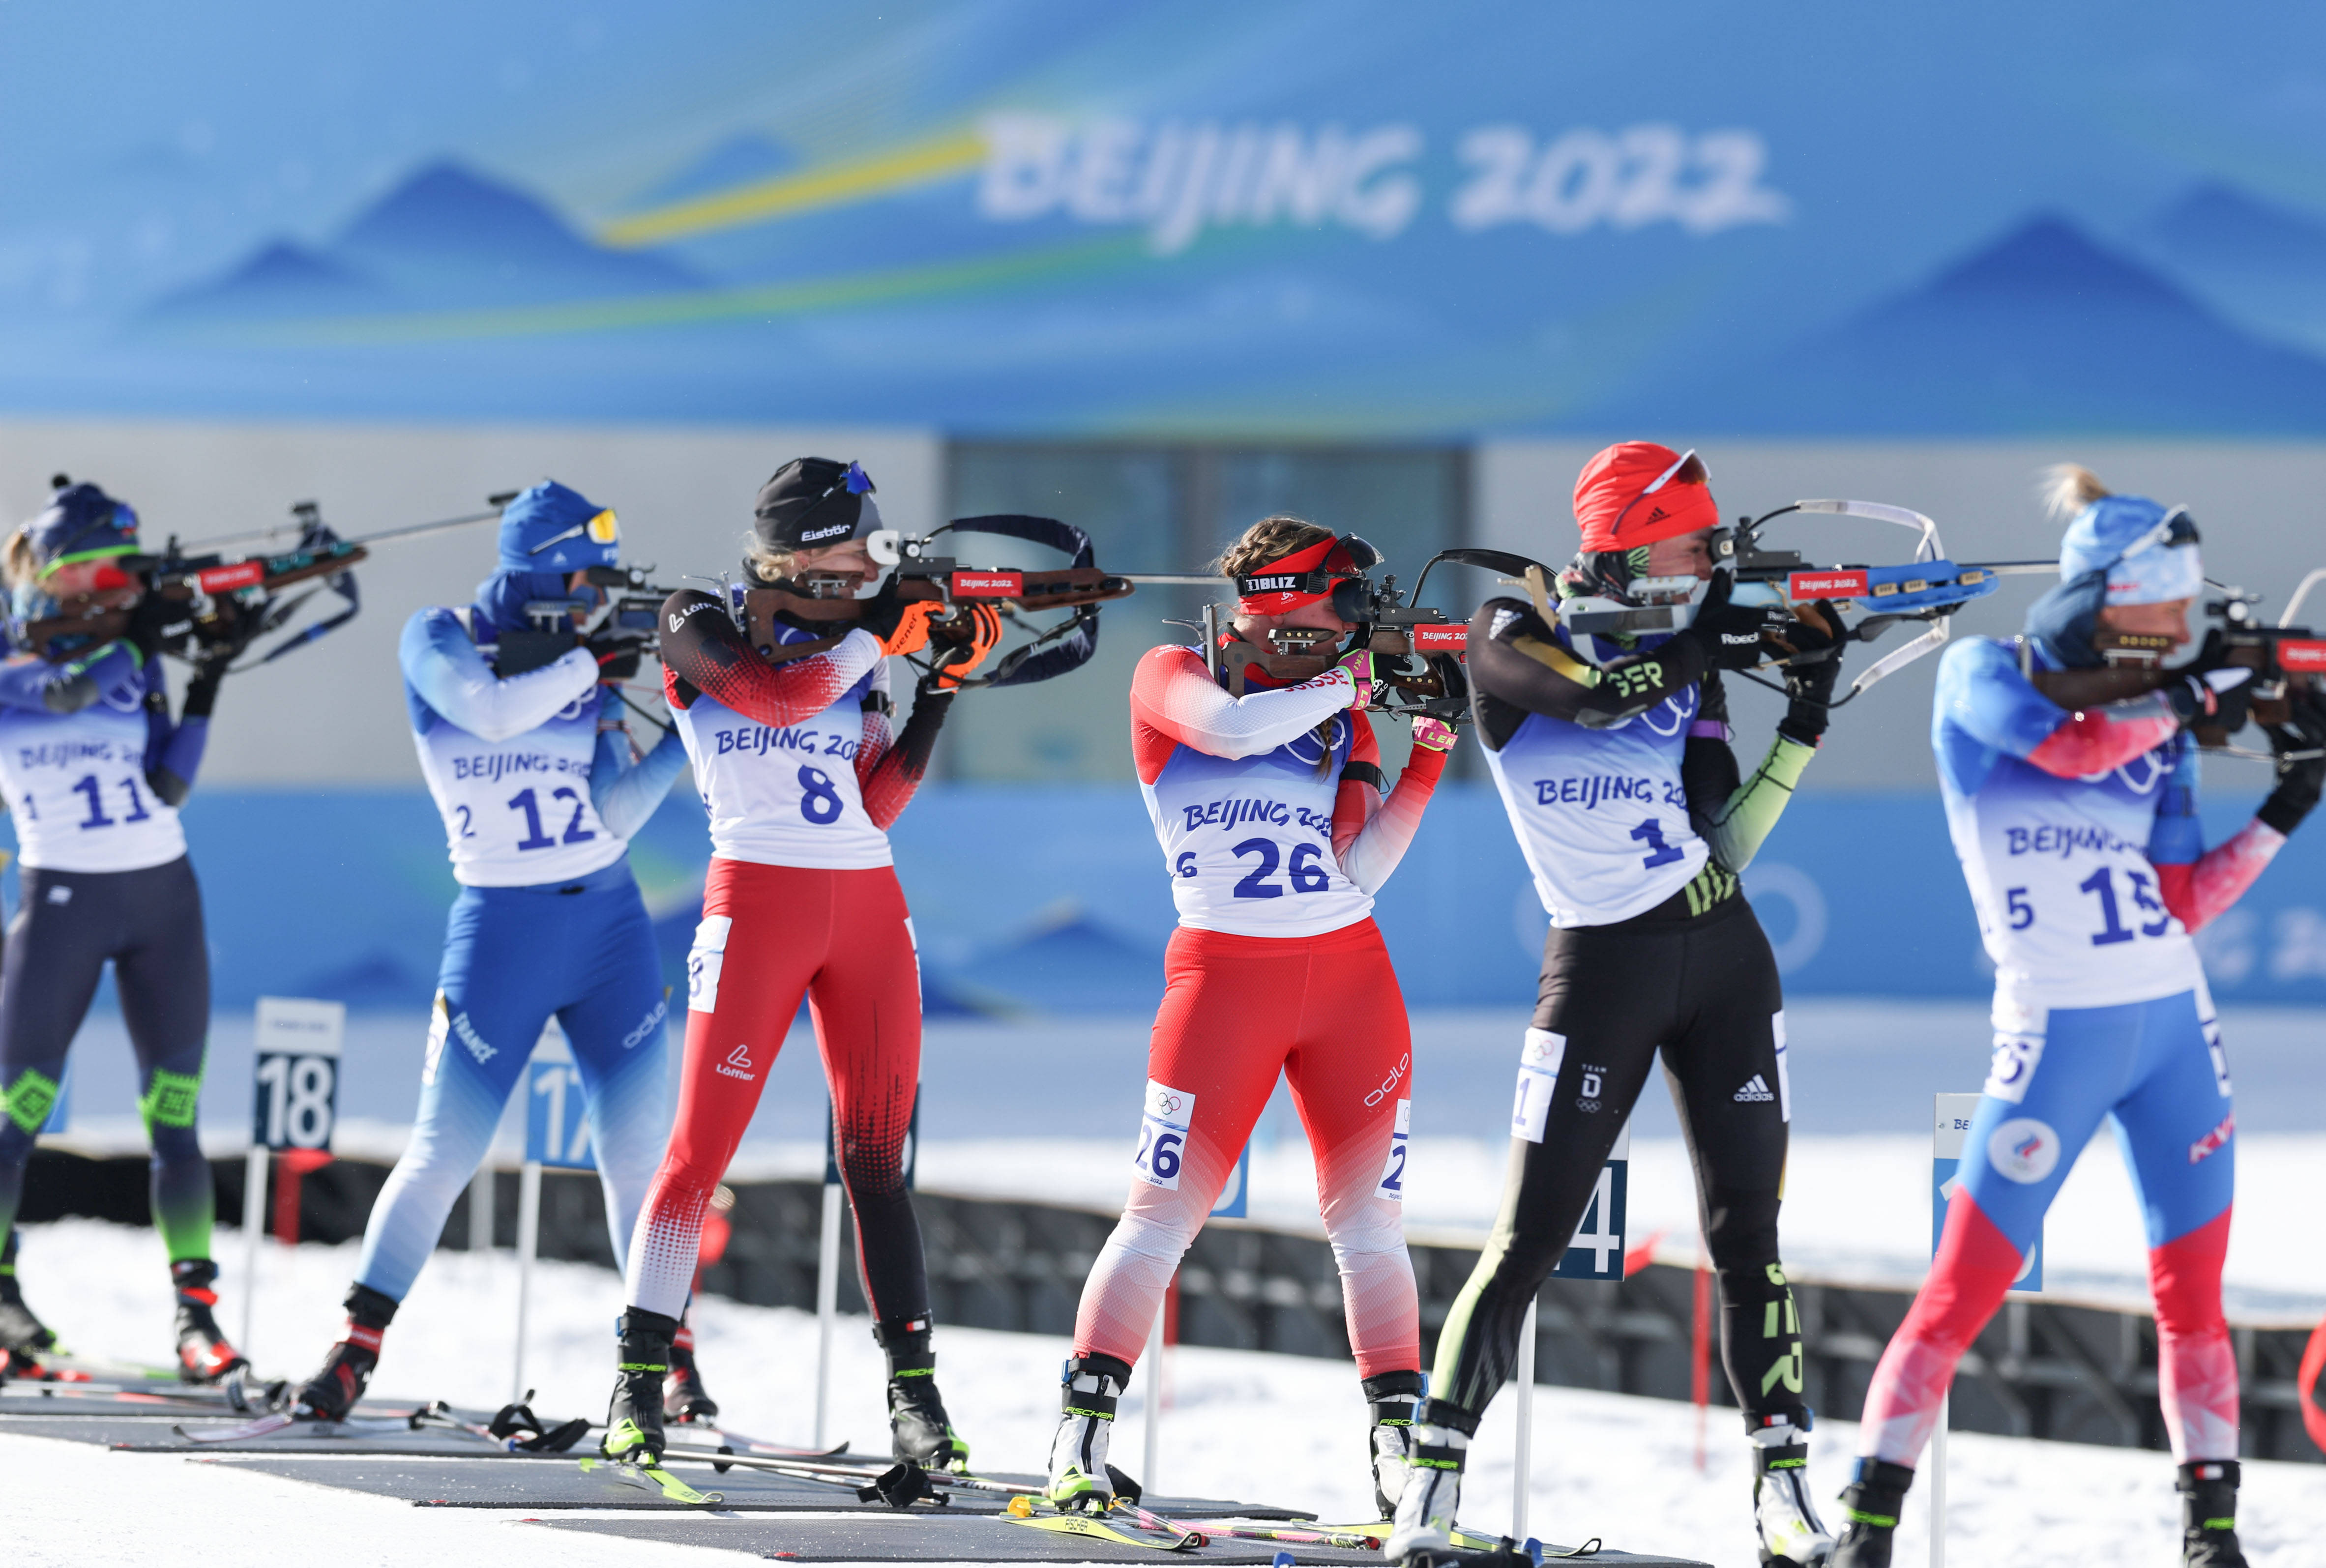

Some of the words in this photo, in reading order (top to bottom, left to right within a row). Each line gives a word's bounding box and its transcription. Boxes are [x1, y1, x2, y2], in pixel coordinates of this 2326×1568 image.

[977, 108, 1424, 257] BEIJING
[1449, 122, 1793, 236] 2022
[801, 524, 851, 542] Eisbär
[960, 579, 990, 589] BEIJING
[1260, 576, 1295, 590] BLIZ
[1799, 580, 1832, 591] BEIJING
[1422, 632, 1453, 642] BEIJING
[1353, 649, 1368, 671] LEKI
[1373, 683, 1389, 699] odlo
[1607, 661, 1664, 698] GER
[1354, 689, 1369, 710] LE
[715, 726, 819, 756] BEIJING
[1427, 731, 1456, 747] LEKI
[453, 754, 549, 783] BEIJING
[72, 775, 150, 830] 11
[797, 764, 844, 825] 8
[1533, 776, 1653, 810] BEIJING
[456, 805, 476, 838] 2
[508, 786, 595, 851] 12
[1182, 799, 1290, 832] BEIJING
[1630, 818, 1685, 870] 1
[1176, 851, 1198, 878] 6
[1231, 837, 1330, 899] 26
[2006, 887, 2034, 930] 5
[2080, 866, 2170, 946] 15
[716, 1063, 755, 1081] Löffler
[1364, 1052, 1409, 1106] odlo
[1582, 1063, 1607, 1074] TEAM
[257, 1056, 333, 1148] 18
[1515, 1077, 1531, 1126] 1
[1733, 1091, 1774, 1102] adidas
[1954, 1119, 1973, 1130] BE
[1135, 1124, 1182, 1179] 26
[1150, 1177, 1163, 1185] 2022
[1381, 1145, 1406, 1191] 2
[1554, 1166, 1619, 1273] 4
[1064, 1406, 1114, 1420] FISCHER
[1065, 1518, 1089, 1533] FISCHER
